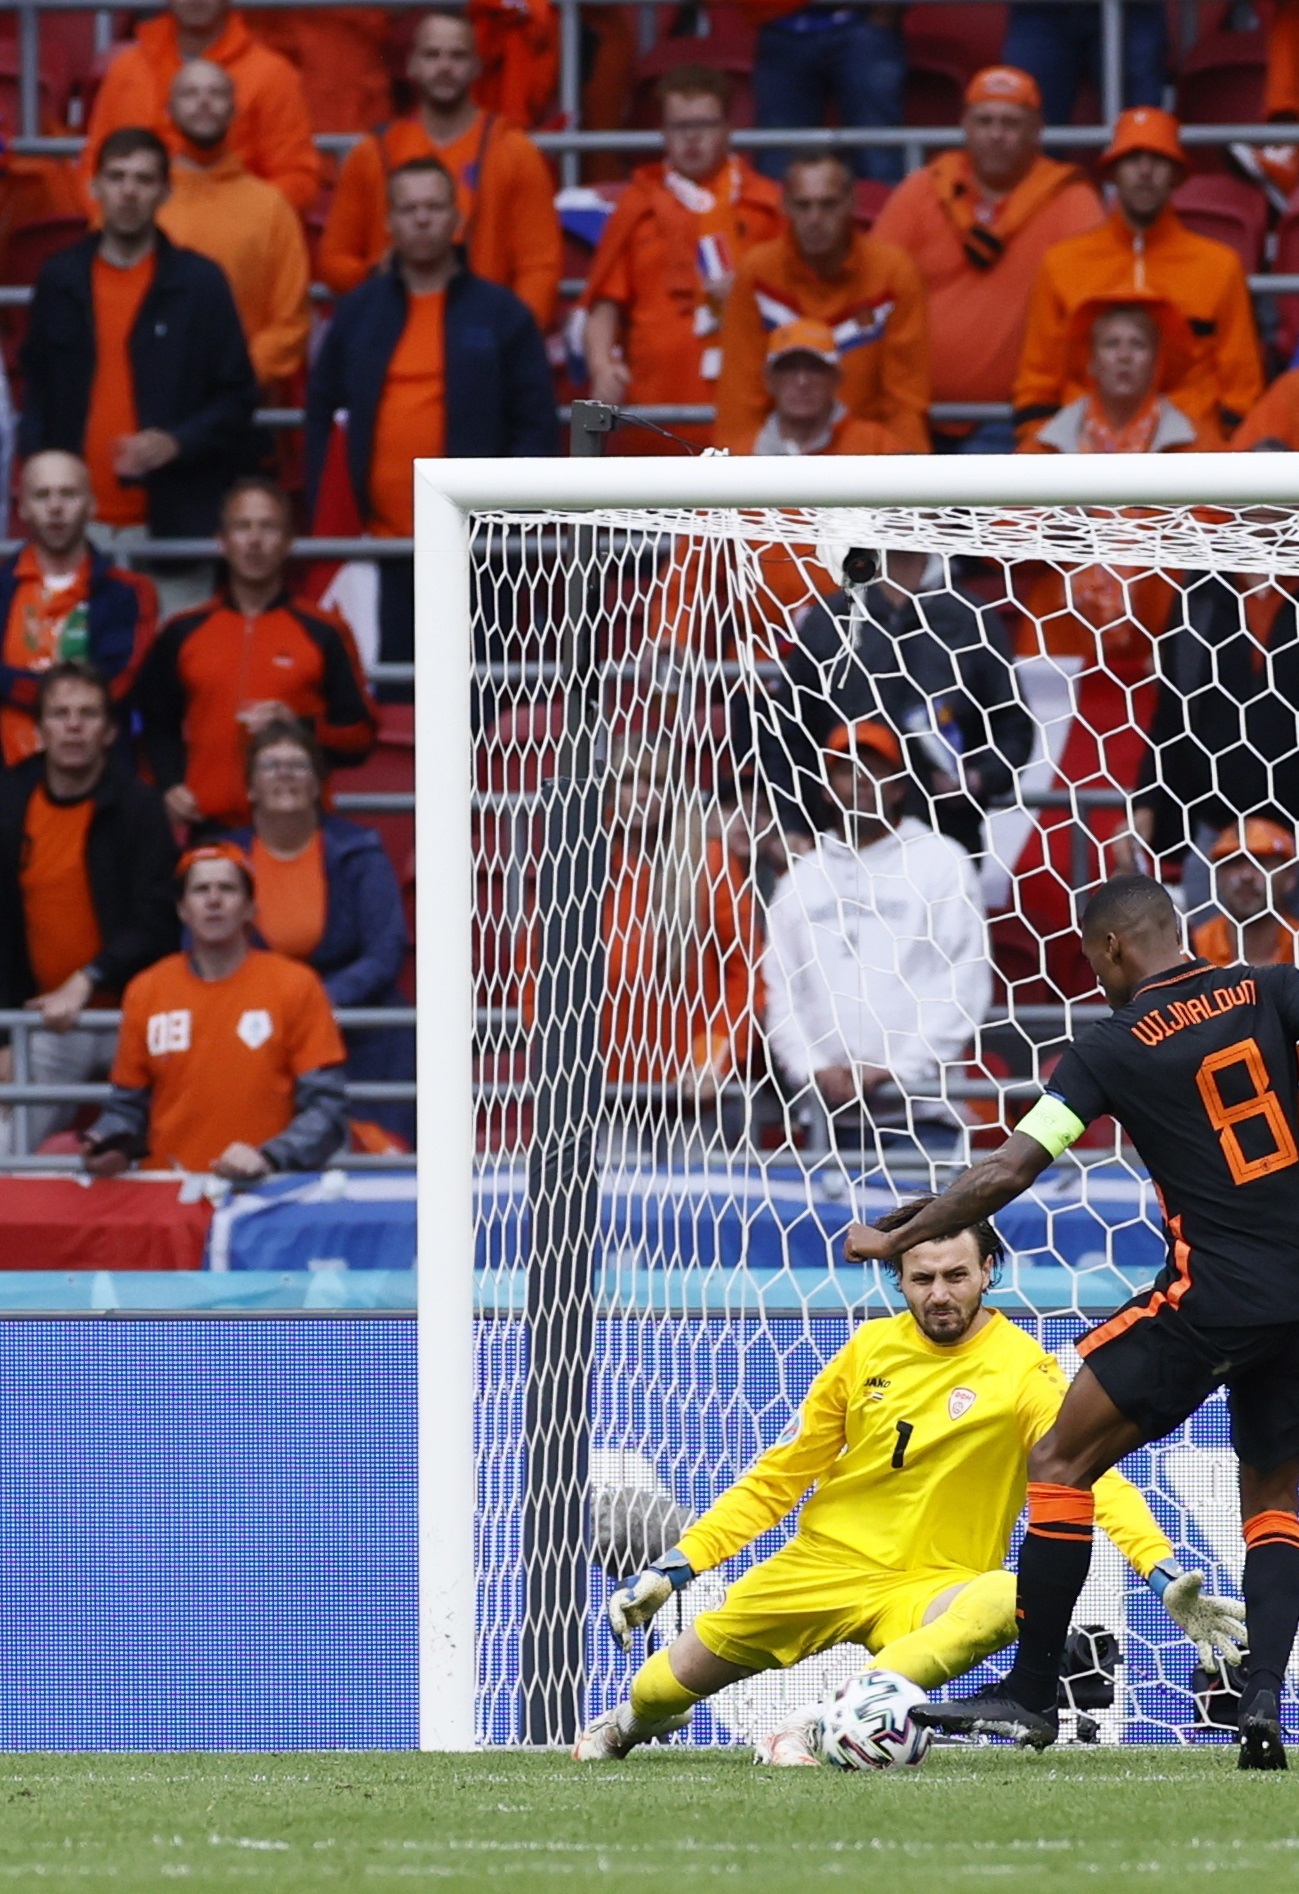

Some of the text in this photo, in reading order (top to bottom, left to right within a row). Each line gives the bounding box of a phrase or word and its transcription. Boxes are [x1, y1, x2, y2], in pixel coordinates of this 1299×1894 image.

[1195, 1037, 1299, 1185] 8
[864, 1378, 891, 1388] JAKO
[892, 1421, 914, 1468] 1
